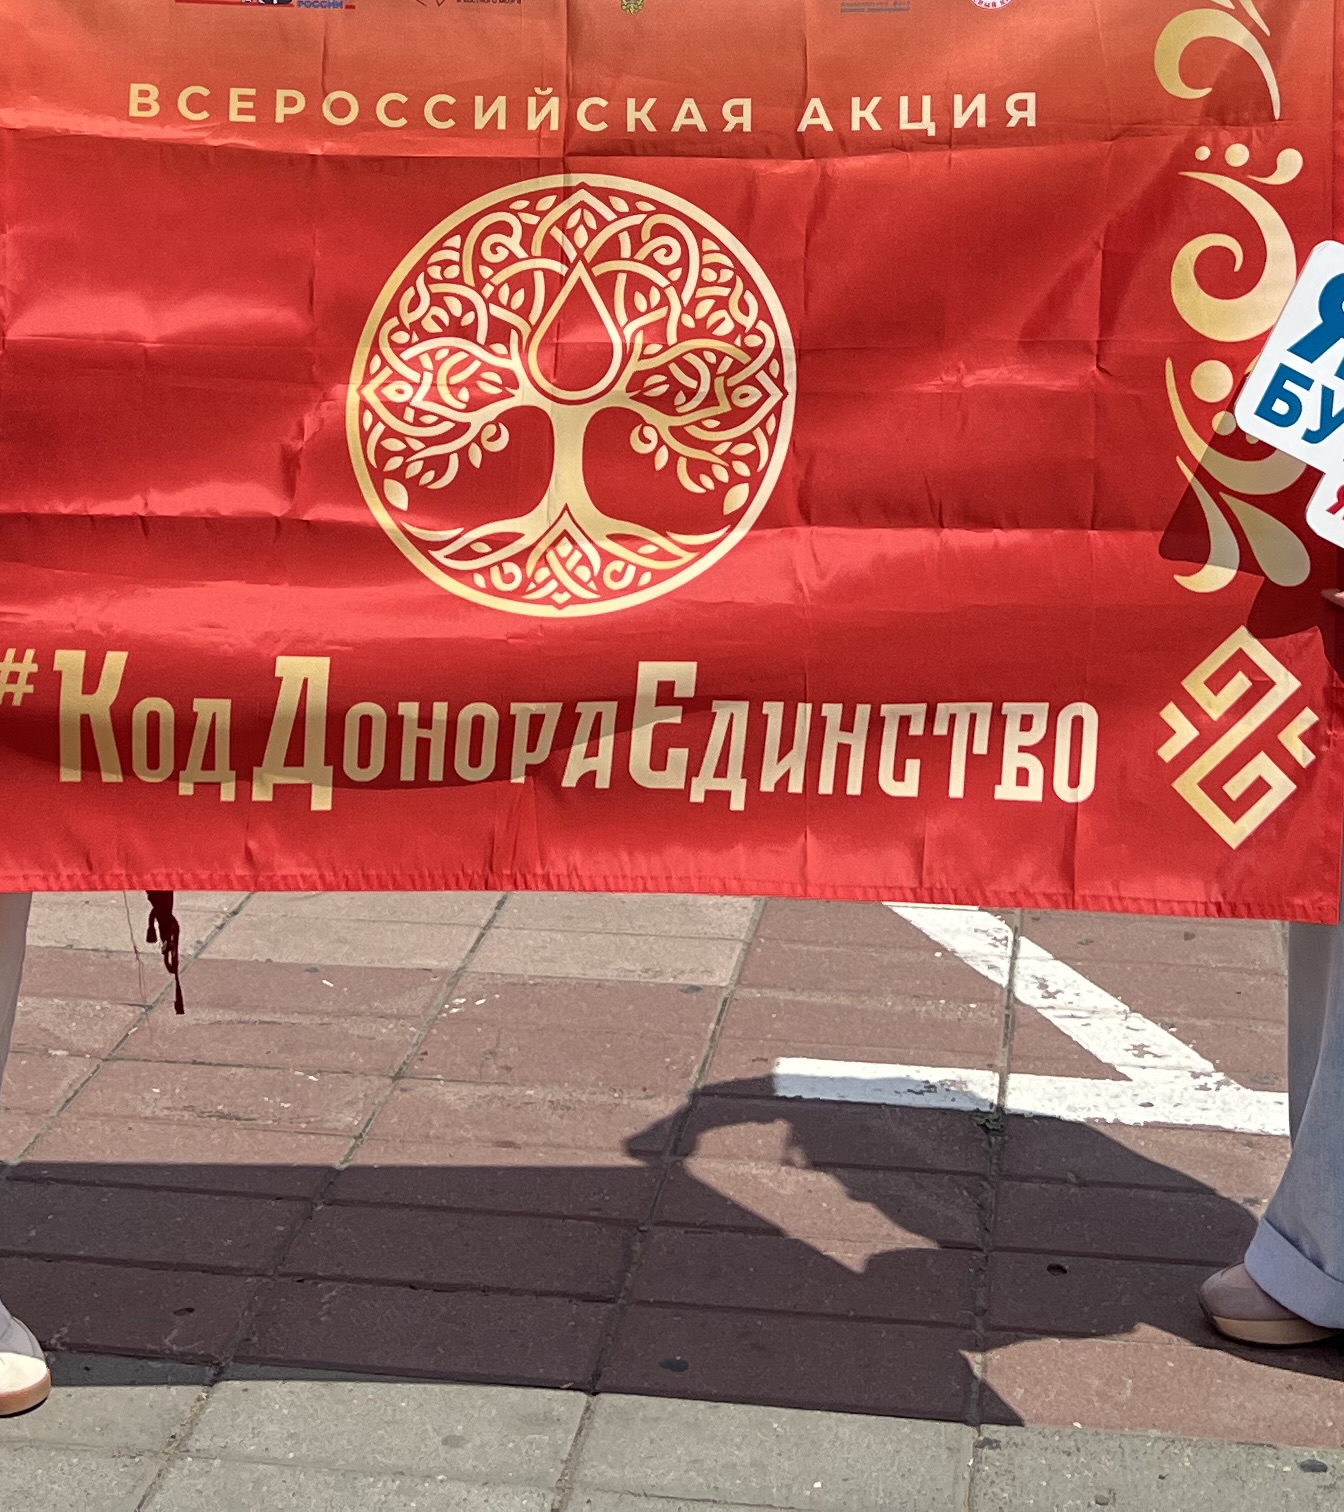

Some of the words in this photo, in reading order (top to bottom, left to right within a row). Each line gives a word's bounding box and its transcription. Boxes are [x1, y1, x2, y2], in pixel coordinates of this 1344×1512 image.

[297, 0, 344, 10] РОССИИ
[128, 82, 753, 135] ВСЕРОССИЙСКАЯ
[796, 91, 1038, 137] АКЦИЯ
